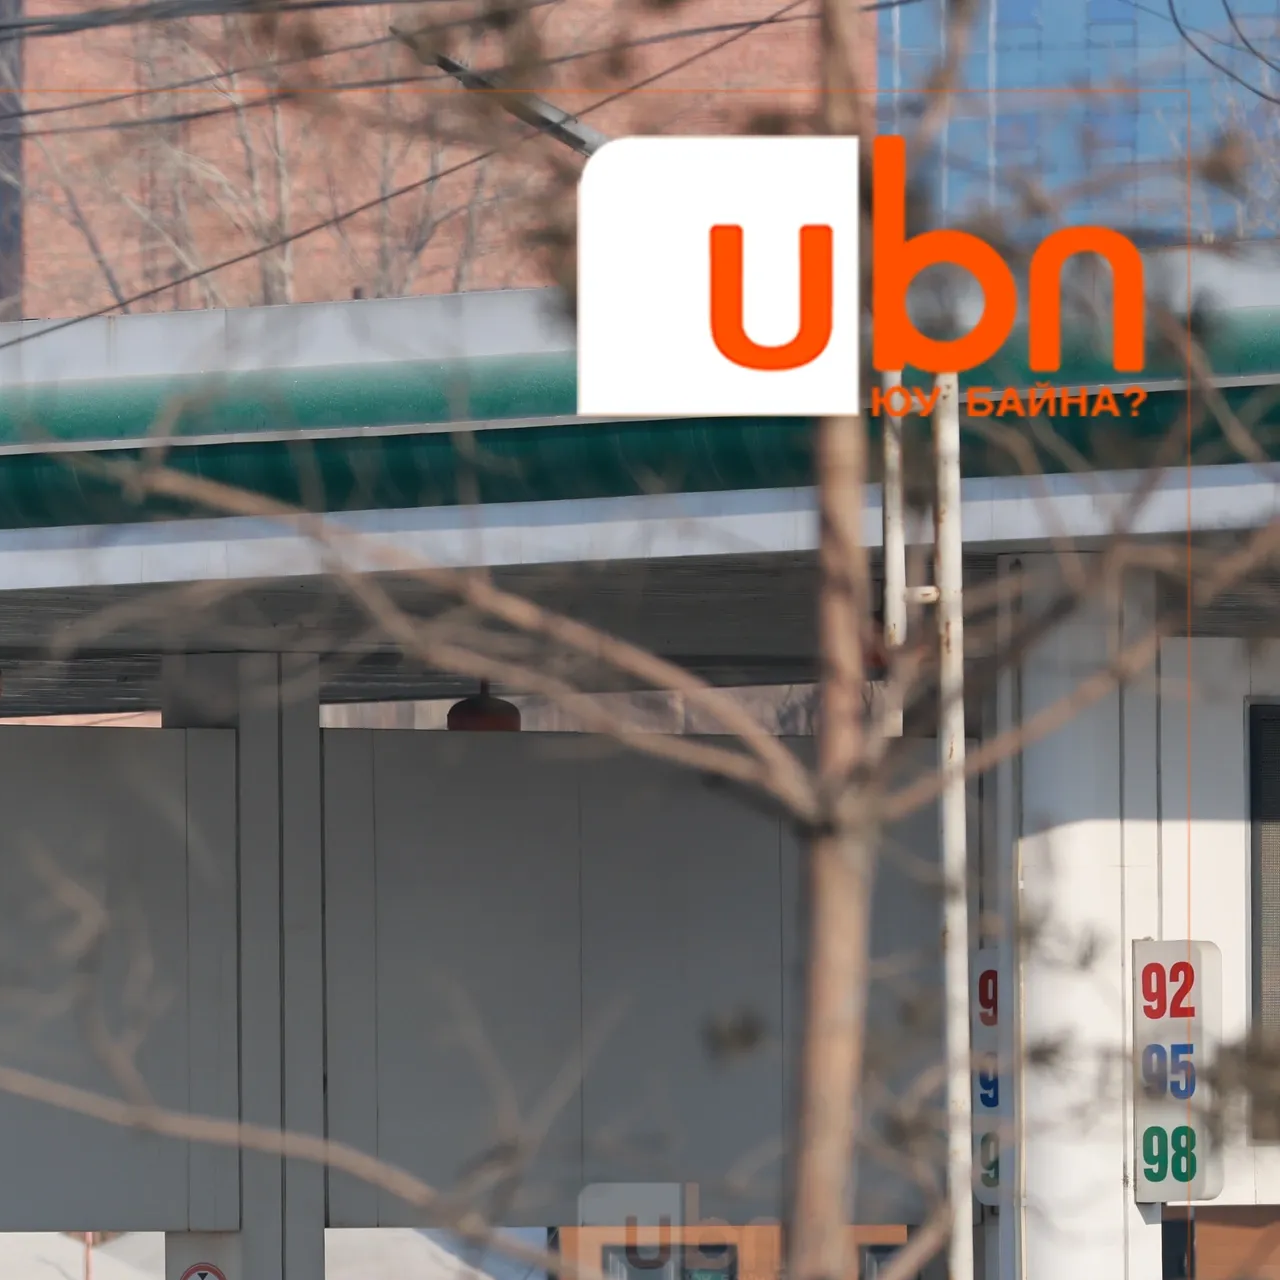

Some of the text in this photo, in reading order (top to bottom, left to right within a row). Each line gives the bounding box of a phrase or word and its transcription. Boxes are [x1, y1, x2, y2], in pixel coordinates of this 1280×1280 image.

[1142, 961, 1196, 1020] 92
[1142, 1044, 1197, 1100] 95
[1143, 1126, 1198, 1183] 98
